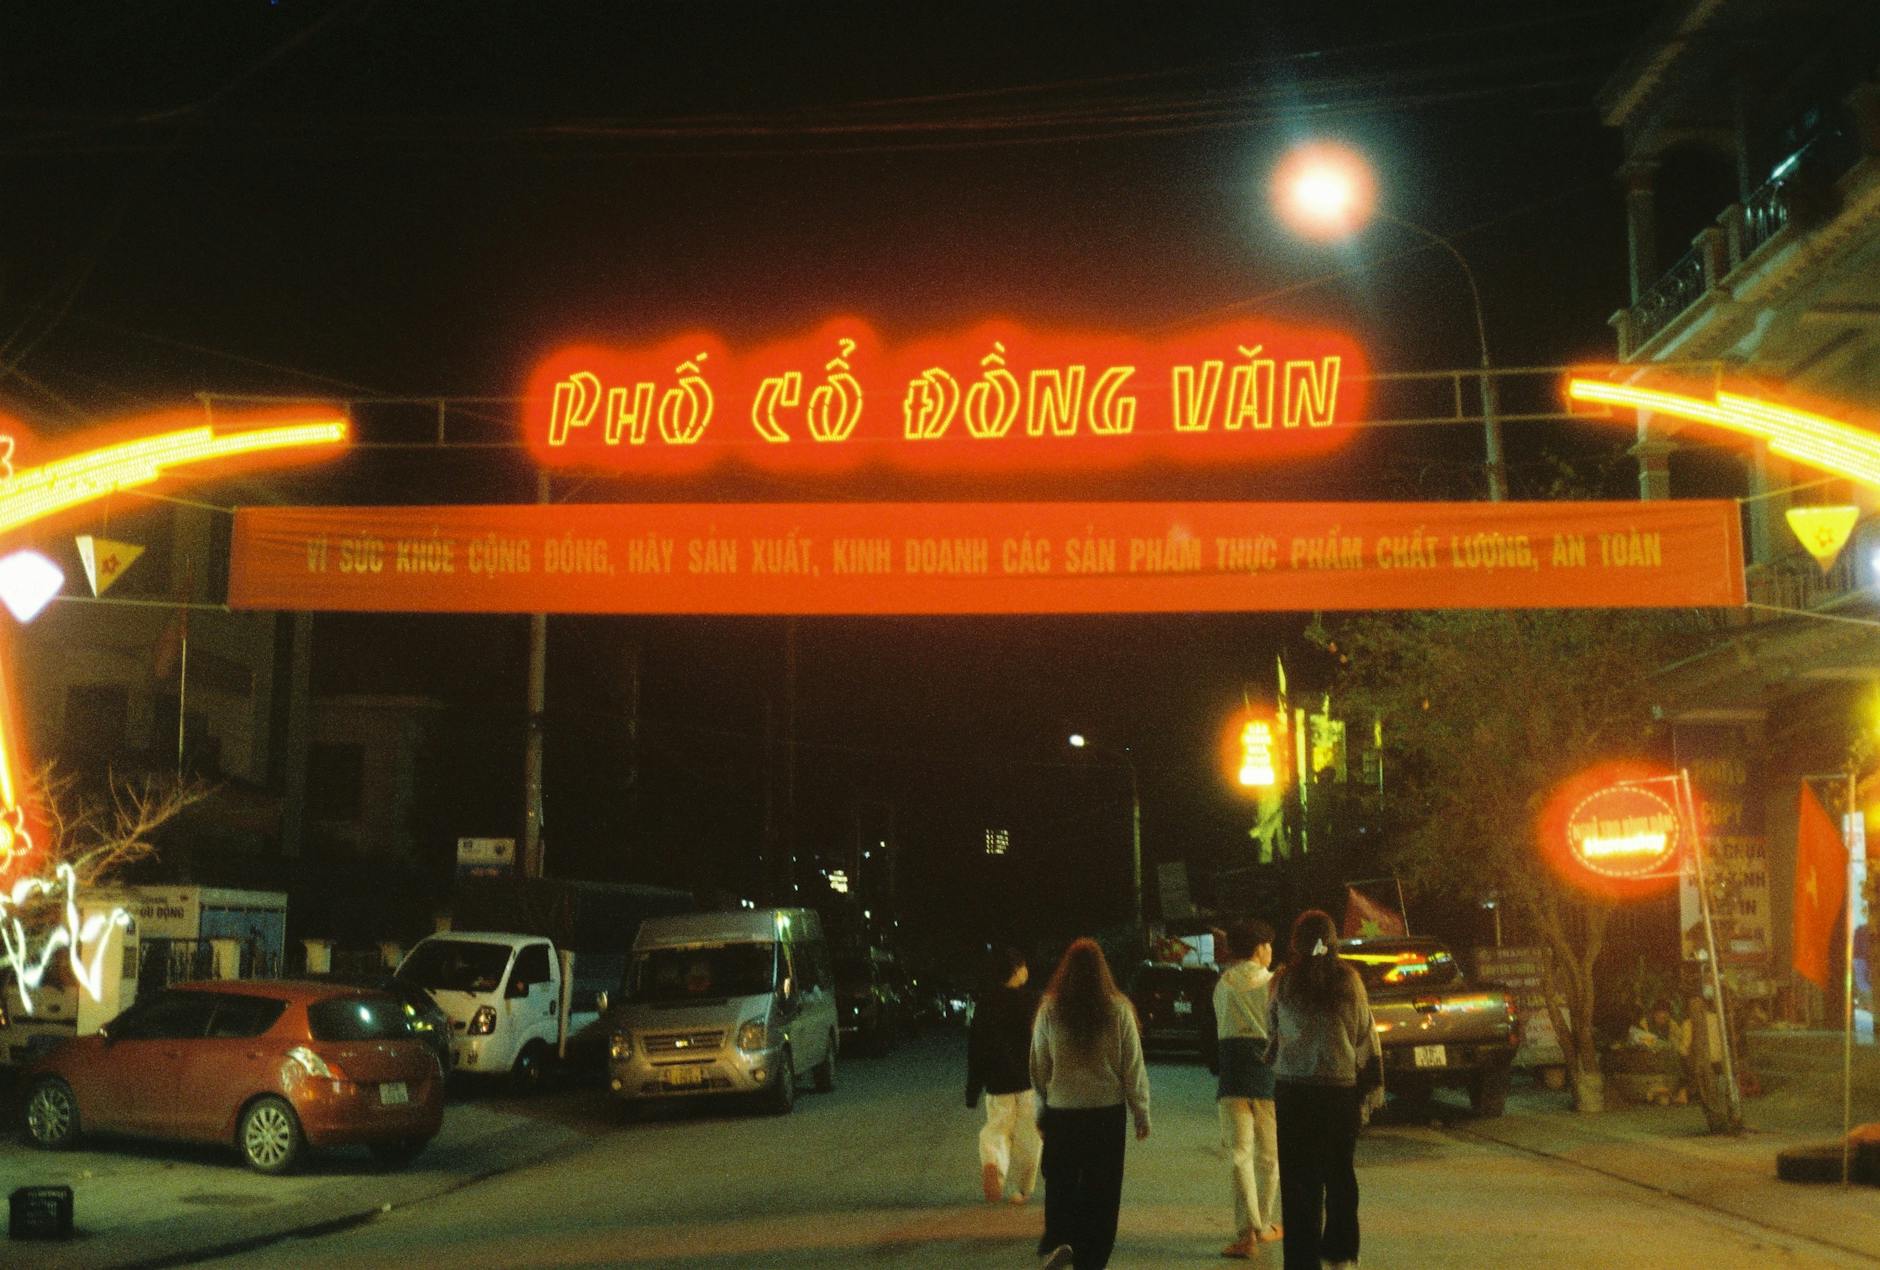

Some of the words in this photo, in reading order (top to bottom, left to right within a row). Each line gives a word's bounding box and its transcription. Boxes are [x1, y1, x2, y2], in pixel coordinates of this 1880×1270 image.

[549, 352, 713, 445] PHỐ
[752, 338, 863, 442] CỔ
[903, 341, 1136, 439] ĐỒNG
[1173, 344, 1341, 431] VĂN
[339, 529, 385, 574] SỨC
[468, 531, 531, 579] CỘNG
[687, 522, 737, 574] SẢN
[751, 525, 820, 577] XUẤT,
[832, 538, 891, 574] KINH
[904, 538, 989, 574] DOANH
[1002, 530, 1051, 574] CÁC
[1064, 523, 1116, 573] SẢN
[1215, 533, 1278, 576] THỰC
[1375, 525, 1440, 569] CHẤT
[1450, 531, 1539, 575] LƯỢNG,
[1552, 533, 1587, 568] AN
[1599, 526, 1662, 569] TOÀN
